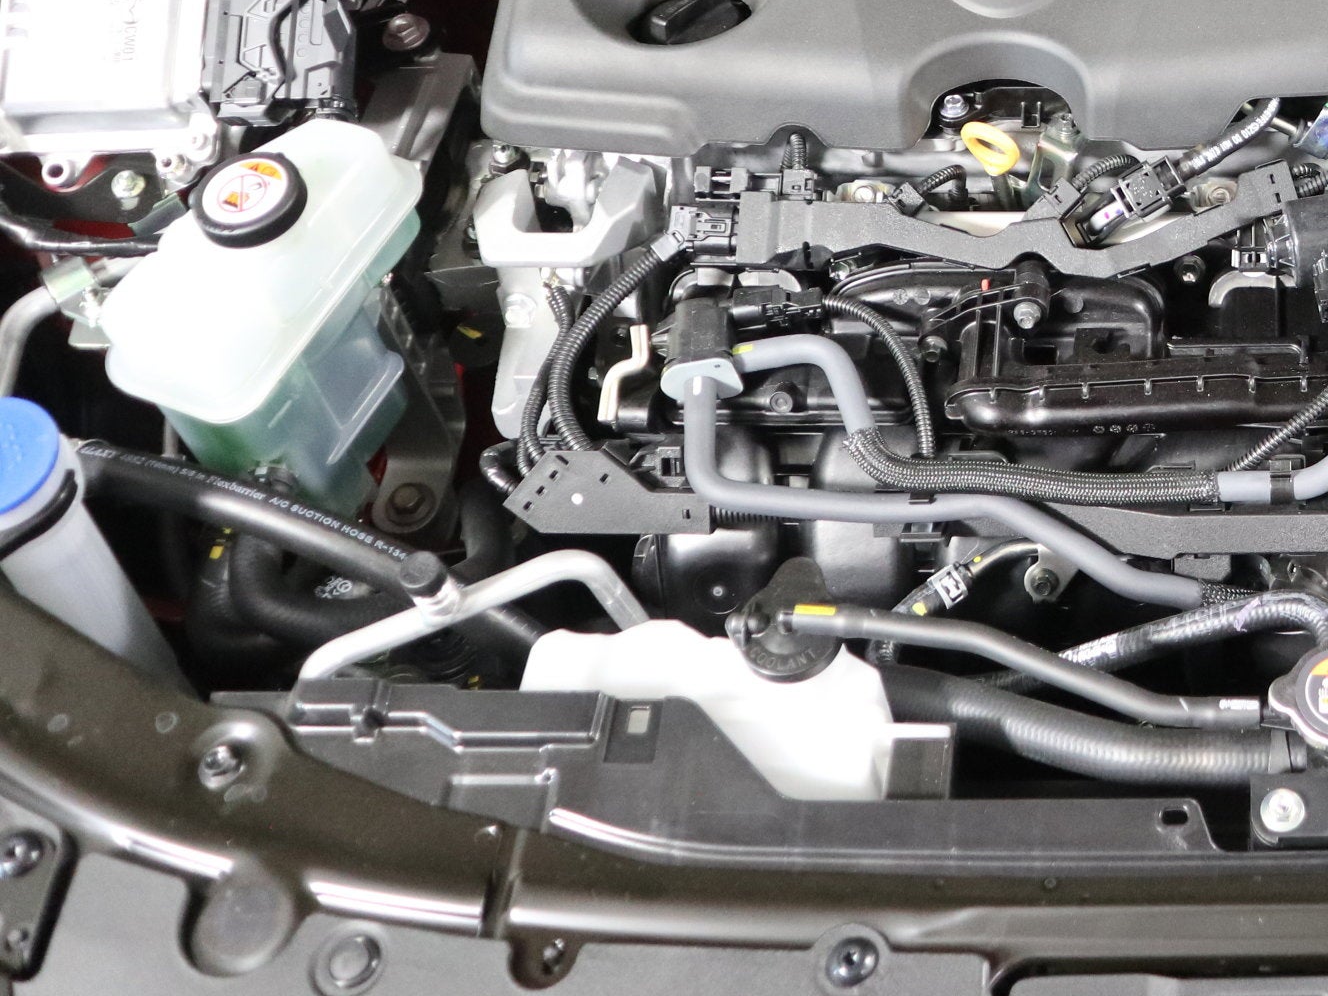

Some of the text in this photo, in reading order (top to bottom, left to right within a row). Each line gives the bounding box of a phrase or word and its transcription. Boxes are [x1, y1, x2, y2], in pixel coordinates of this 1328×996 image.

[206, 475, 267, 501] Flexbarrier
[268, 496, 289, 508] A/C
[289, 504, 341, 530] SUCTION
[340, 524, 375, 544] HOSE
[750, 648, 816, 670] COOLANT
